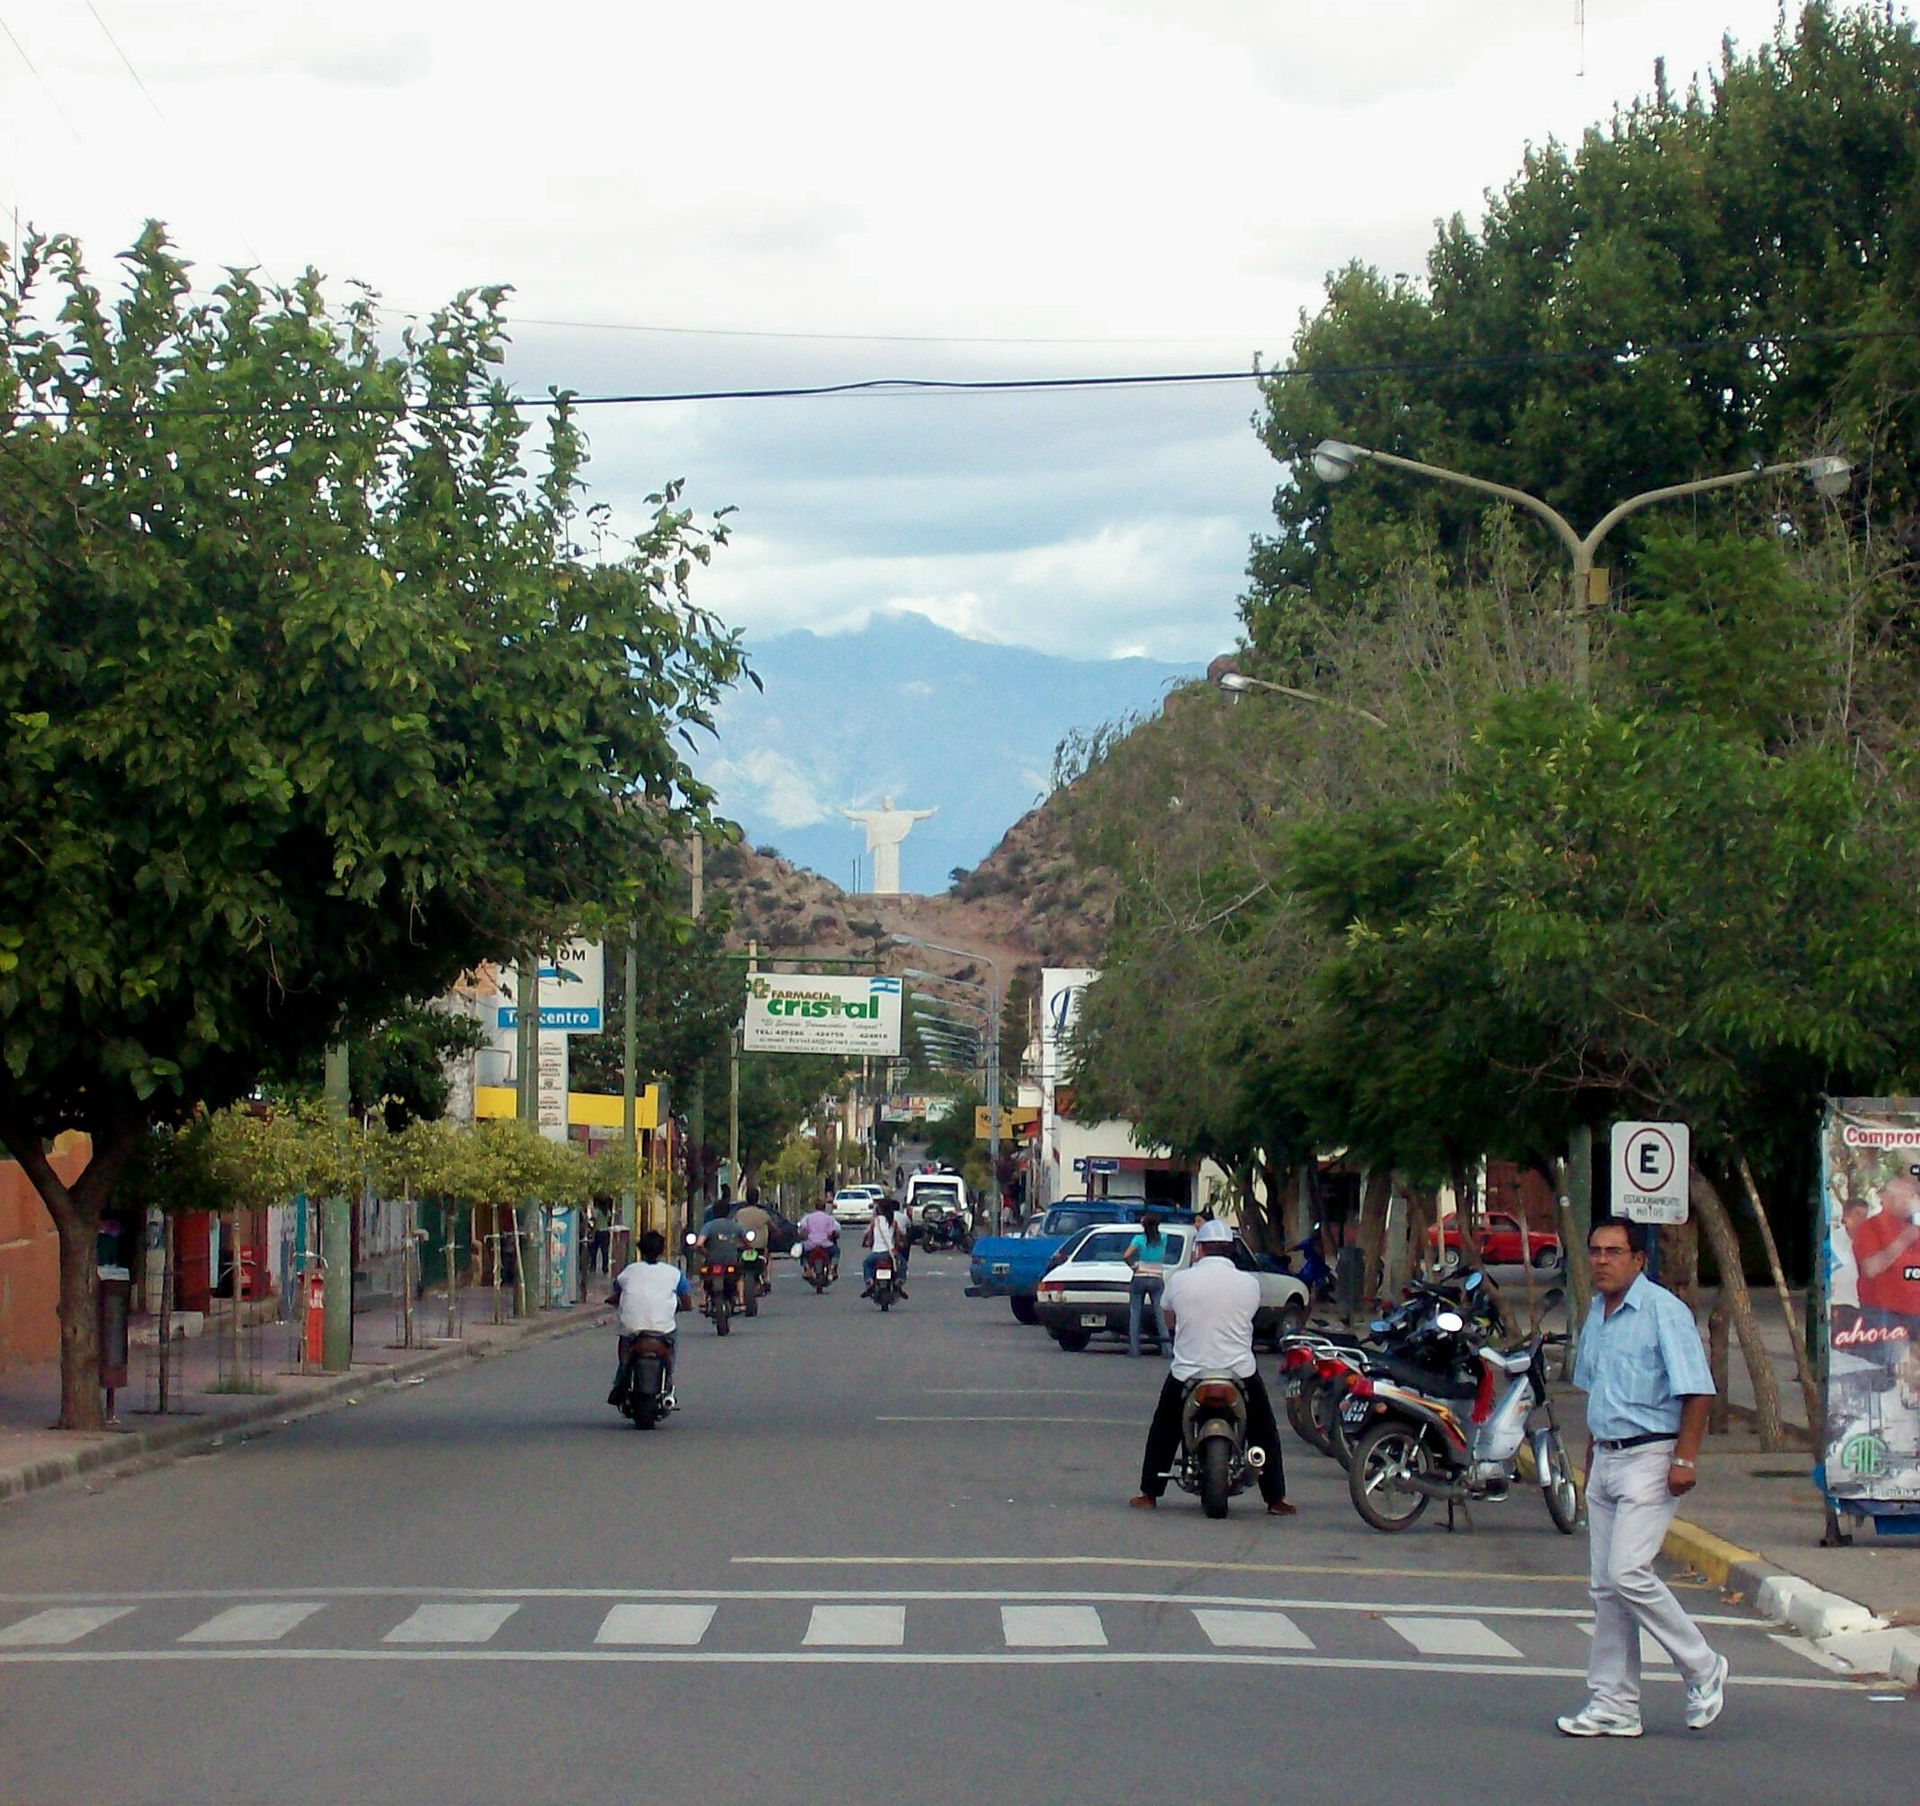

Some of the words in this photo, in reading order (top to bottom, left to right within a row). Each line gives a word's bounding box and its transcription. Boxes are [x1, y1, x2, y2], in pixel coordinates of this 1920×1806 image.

[767, 995, 880, 1019] cristal
[771, 989, 832, 1000] FARMACIA
[1640, 1144, 1660, 1174] E
[1834, 1316, 1909, 1345] ahora
